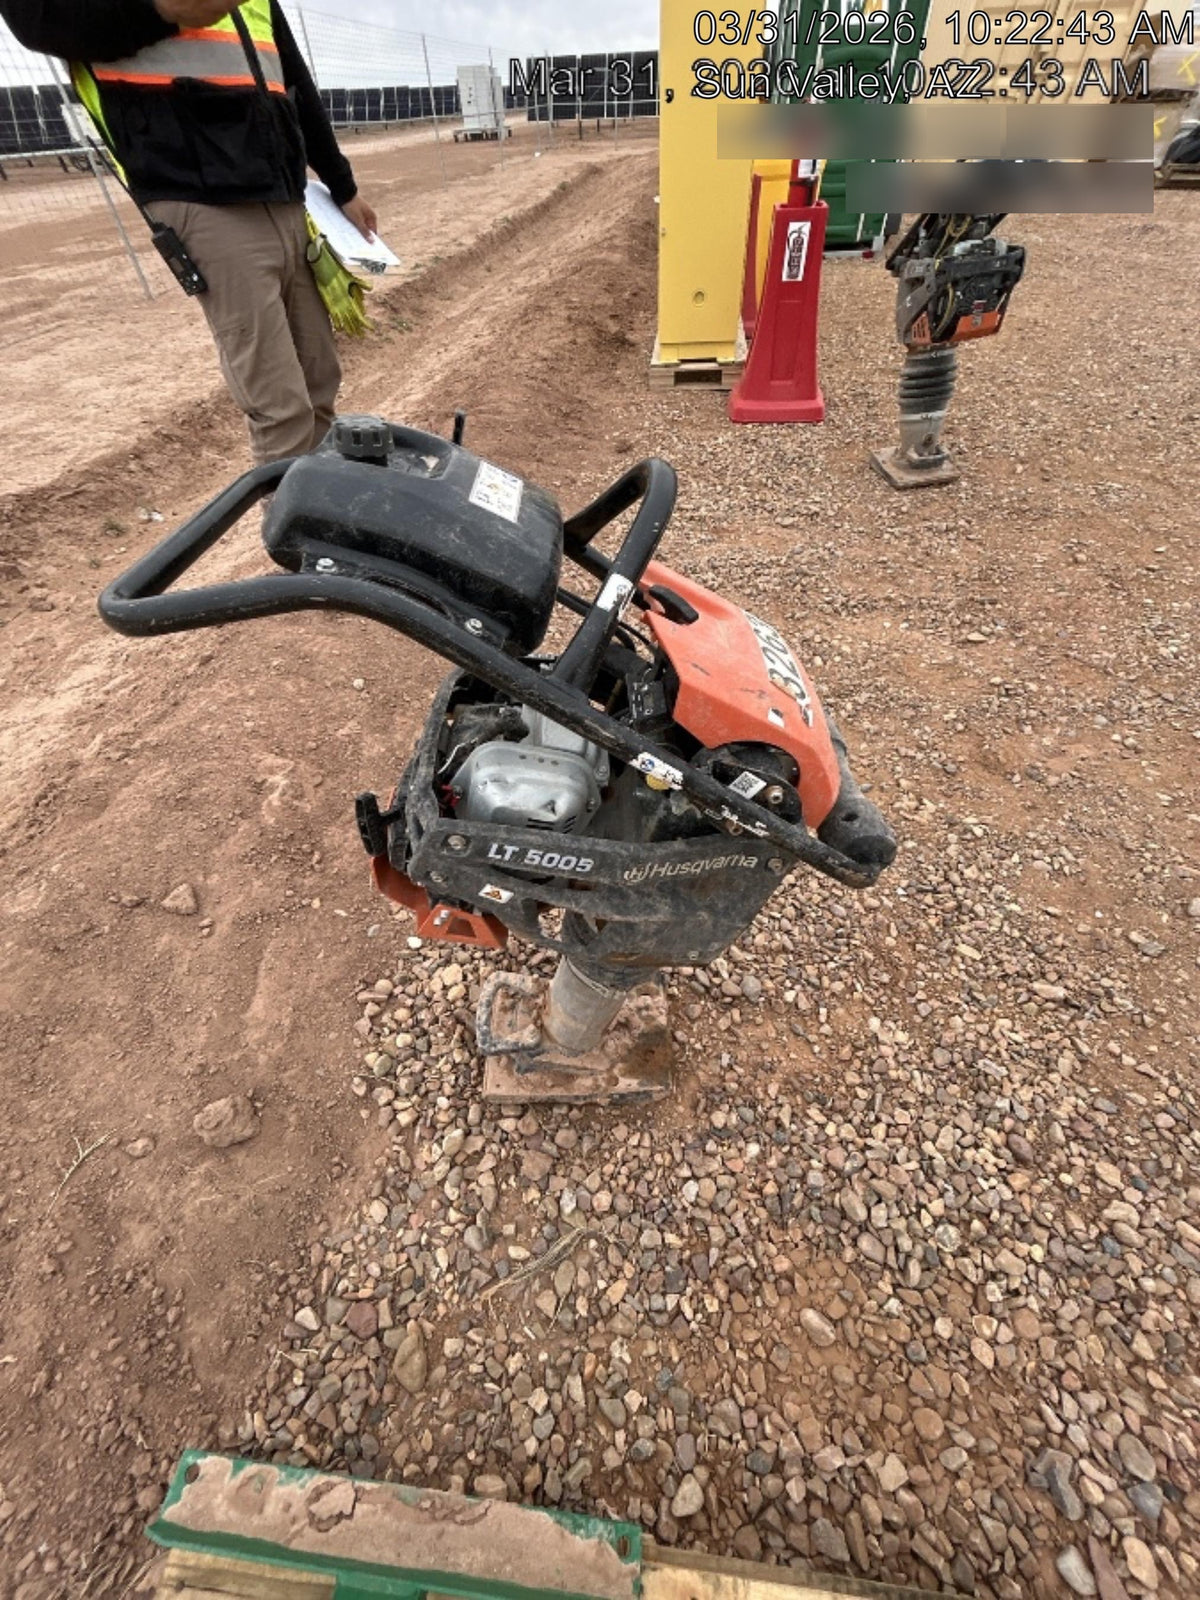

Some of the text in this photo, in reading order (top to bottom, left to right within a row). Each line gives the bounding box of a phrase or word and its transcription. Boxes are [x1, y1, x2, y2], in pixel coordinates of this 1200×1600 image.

[487, 842, 595, 872] LT 5005
[649, 854, 759, 876] Husqvarna
